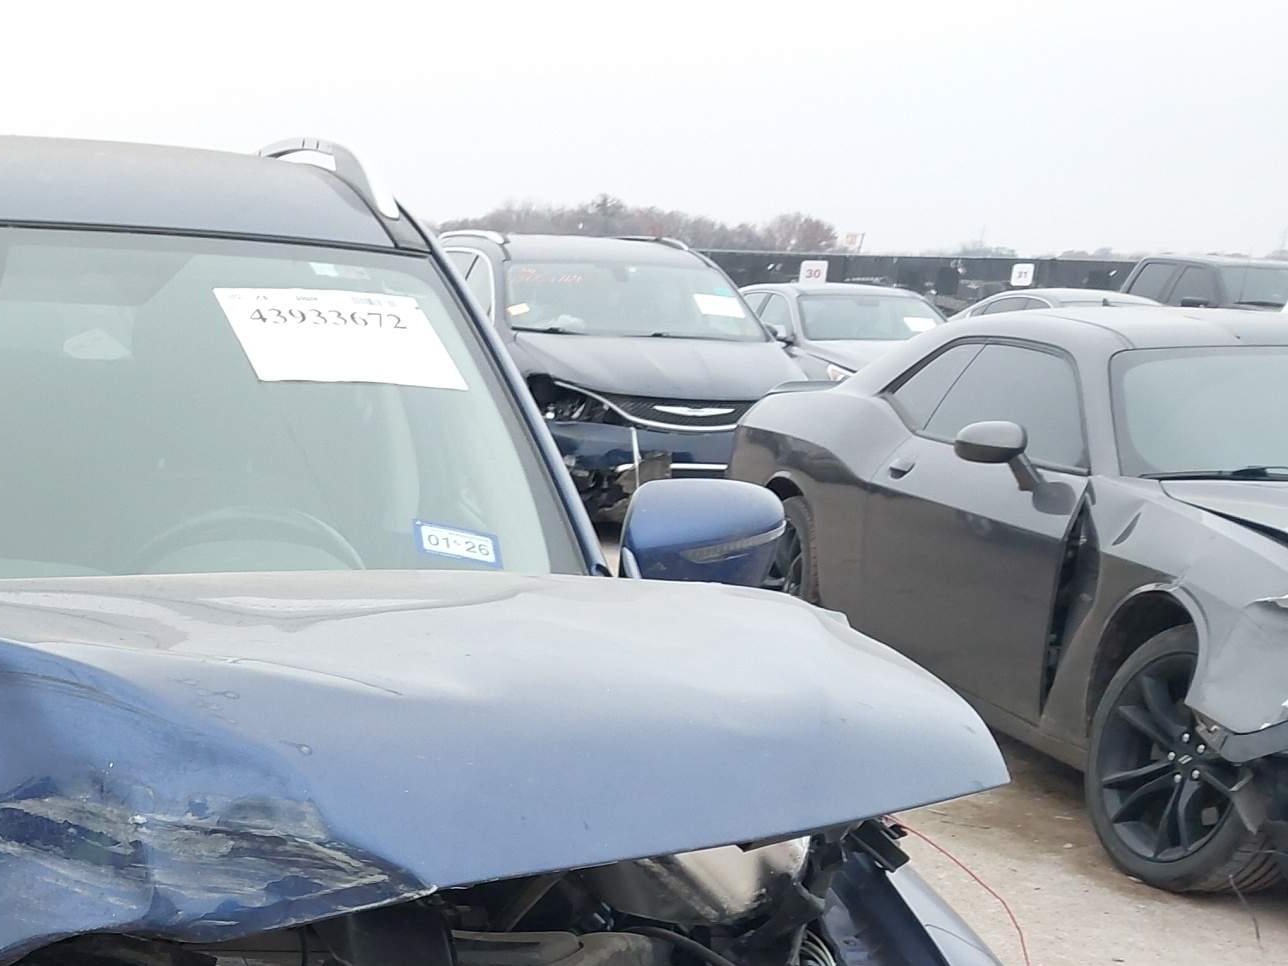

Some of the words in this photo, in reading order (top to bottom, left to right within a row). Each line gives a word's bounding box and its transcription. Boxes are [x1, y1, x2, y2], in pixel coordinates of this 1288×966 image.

[805, 268, 821, 279] 30
[249, 307, 409, 330] 43933672
[427, 534, 451, 549] 01
[464, 540, 490, 556] 26
